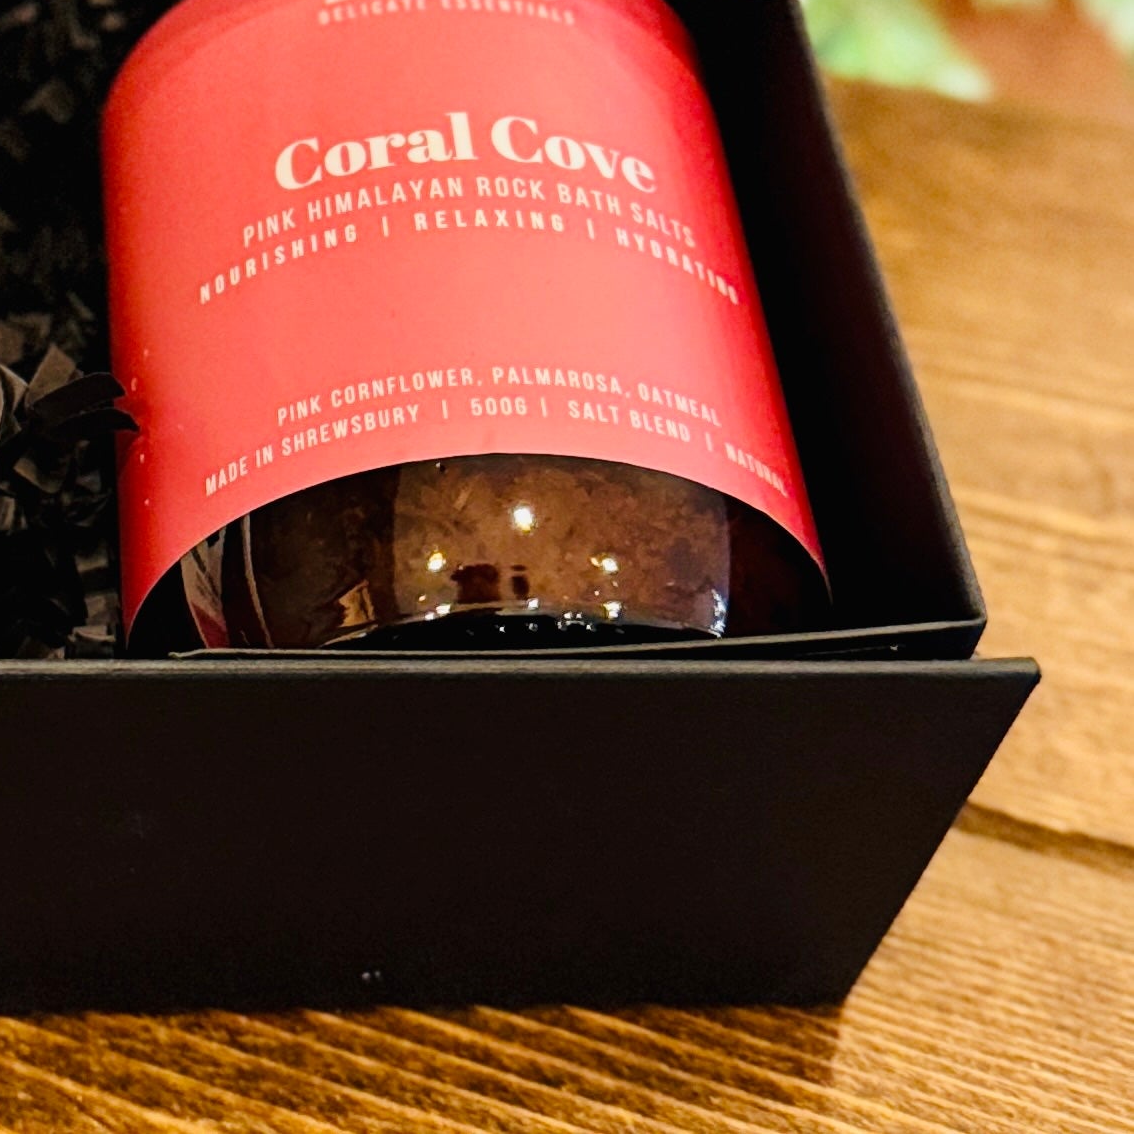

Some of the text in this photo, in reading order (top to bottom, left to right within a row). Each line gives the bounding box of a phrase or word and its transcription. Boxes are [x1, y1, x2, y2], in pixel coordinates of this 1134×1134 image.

[275, 112, 656, 193] Coral Cove
[243, 177, 696, 248] PINK HIMALAYAN ROCK BATH SALTS
[200, 224, 357, 304] NOURISHING
[414, 209, 565, 232] RELAXING
[616, 227, 738, 305] HYDRATING
[277, 395, 322, 426] PINK
[638, 383, 722, 427] OATMEAL
[205, 456, 249, 497] MADE
[255, 445, 274, 468] IN
[281, 404, 419, 457] SHREWSBURY
[471, 397, 527, 416] 500G
[568, 400, 620, 425] SALT
[630, 410, 691, 443] BLEND
[724, 442, 788, 498] NATURAL
